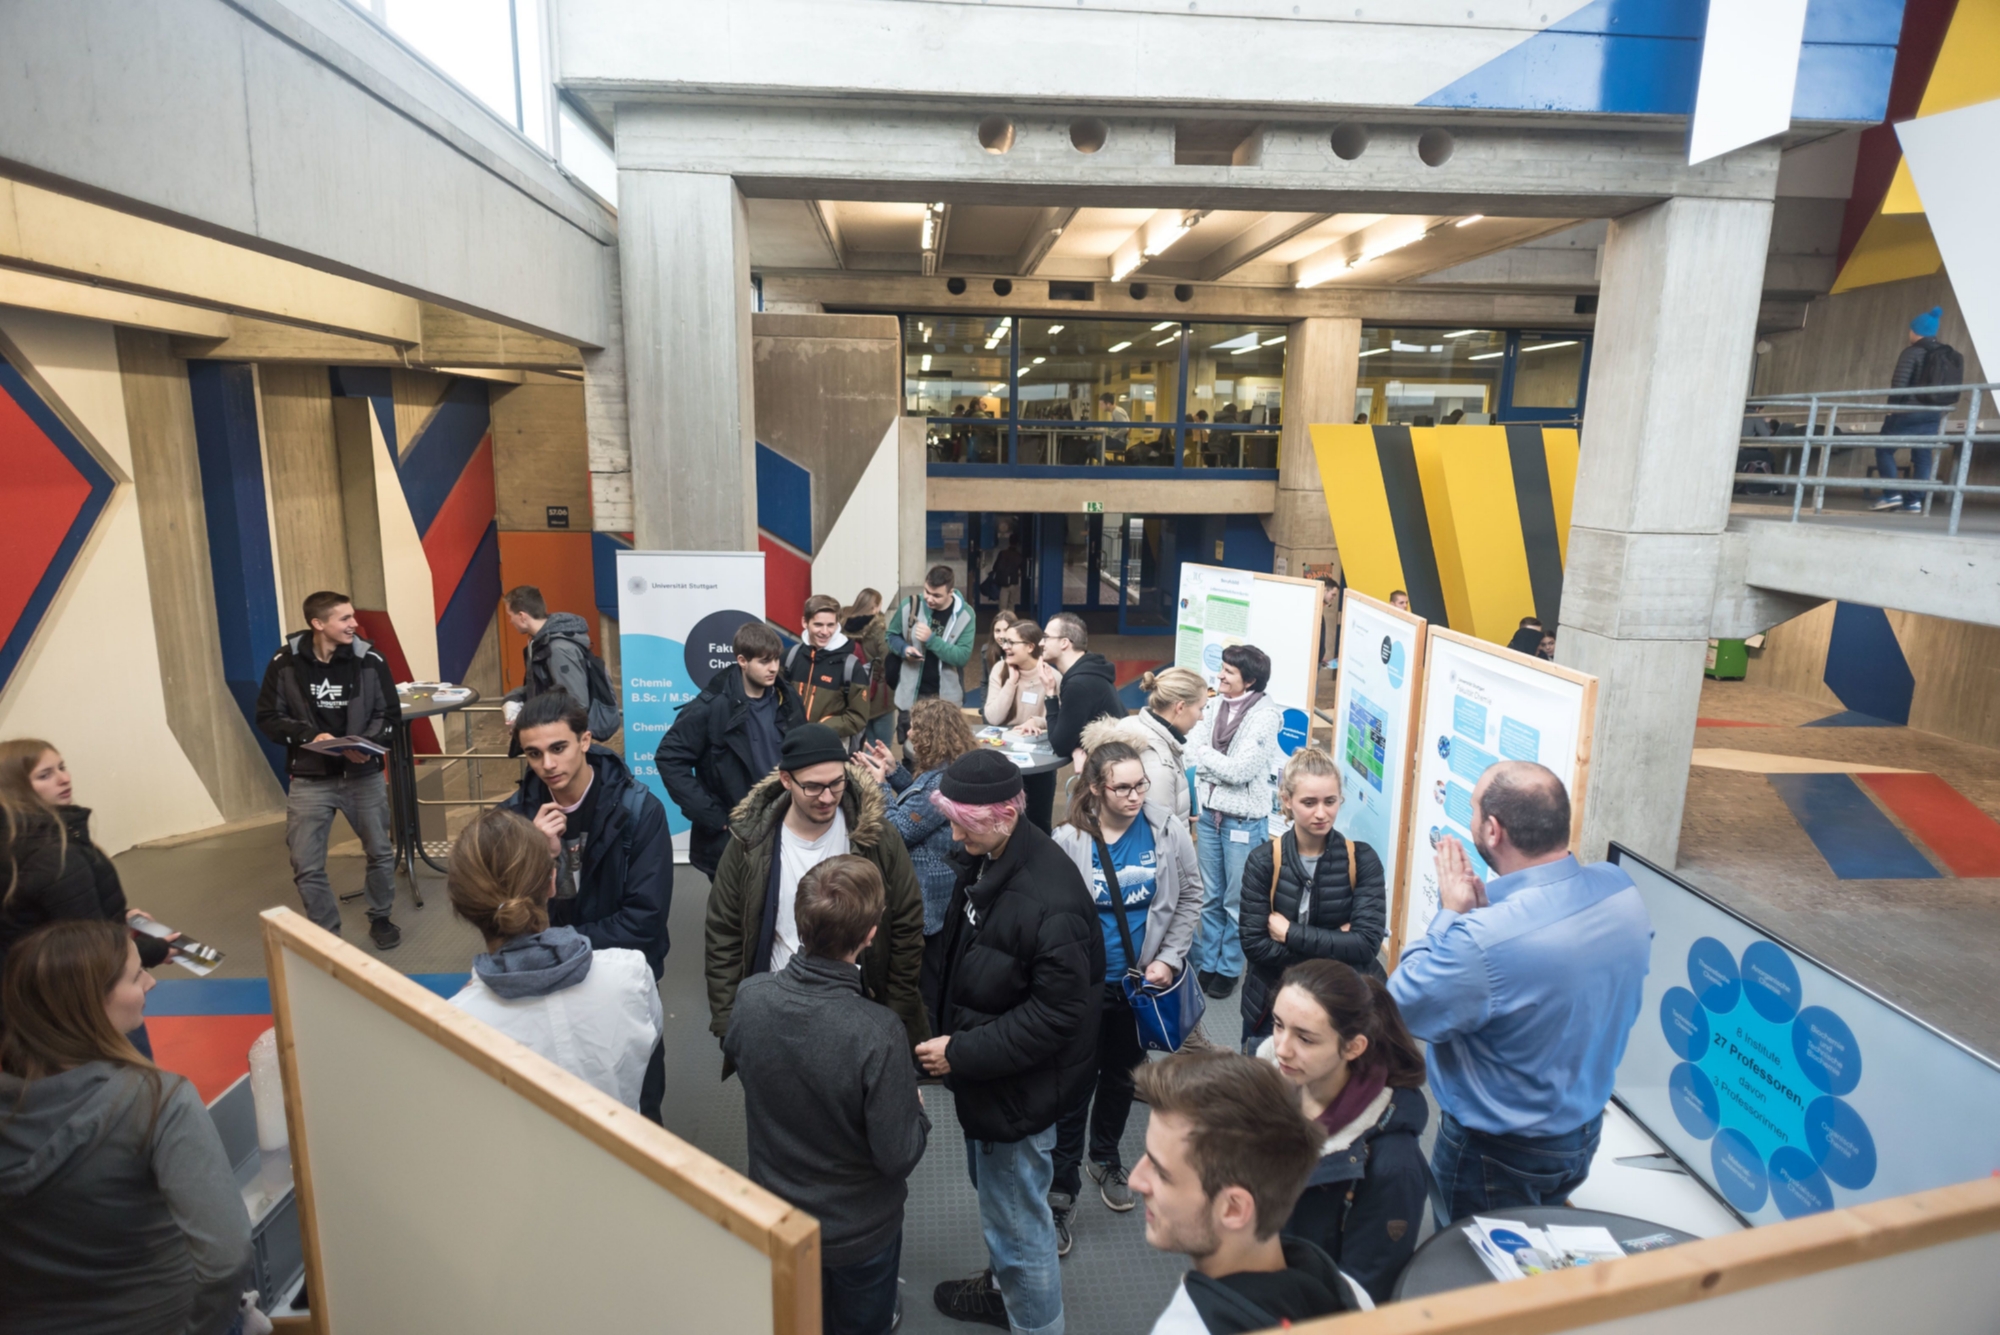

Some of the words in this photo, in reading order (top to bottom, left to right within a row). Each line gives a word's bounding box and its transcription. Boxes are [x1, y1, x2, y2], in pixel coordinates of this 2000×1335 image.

[708, 659, 738, 669] Che
[631, 678, 672, 688] Chemie
[631, 693, 660, 702] B.Sc.
[1751, 964, 1791, 993] Anorganische
[1758, 977, 1782, 996] Chemie
[1736, 1027, 1743, 1038] 8
[1744, 1033, 1783, 1070] Institute,
[1810, 1024, 1845, 1052] Biochemie
[1819, 1041, 1833, 1053] und
[1806, 1048, 1840, 1077] Biochemie
[1808, 1039, 1843, 1069] Technische
[1714, 1032, 1728, 1049] 27
[1729, 1043, 1805, 1112] Professoren,
[1738, 1077, 1767, 1104] davon
[1713, 1076, 1719, 1087] 3
[1720, 1081, 1789, 1143] Professorinnen
[1821, 1121, 1860, 1155] Organische
[1825, 1133, 1852, 1158] Chemie
[1787, 1183, 1812, 1207] Chemie
